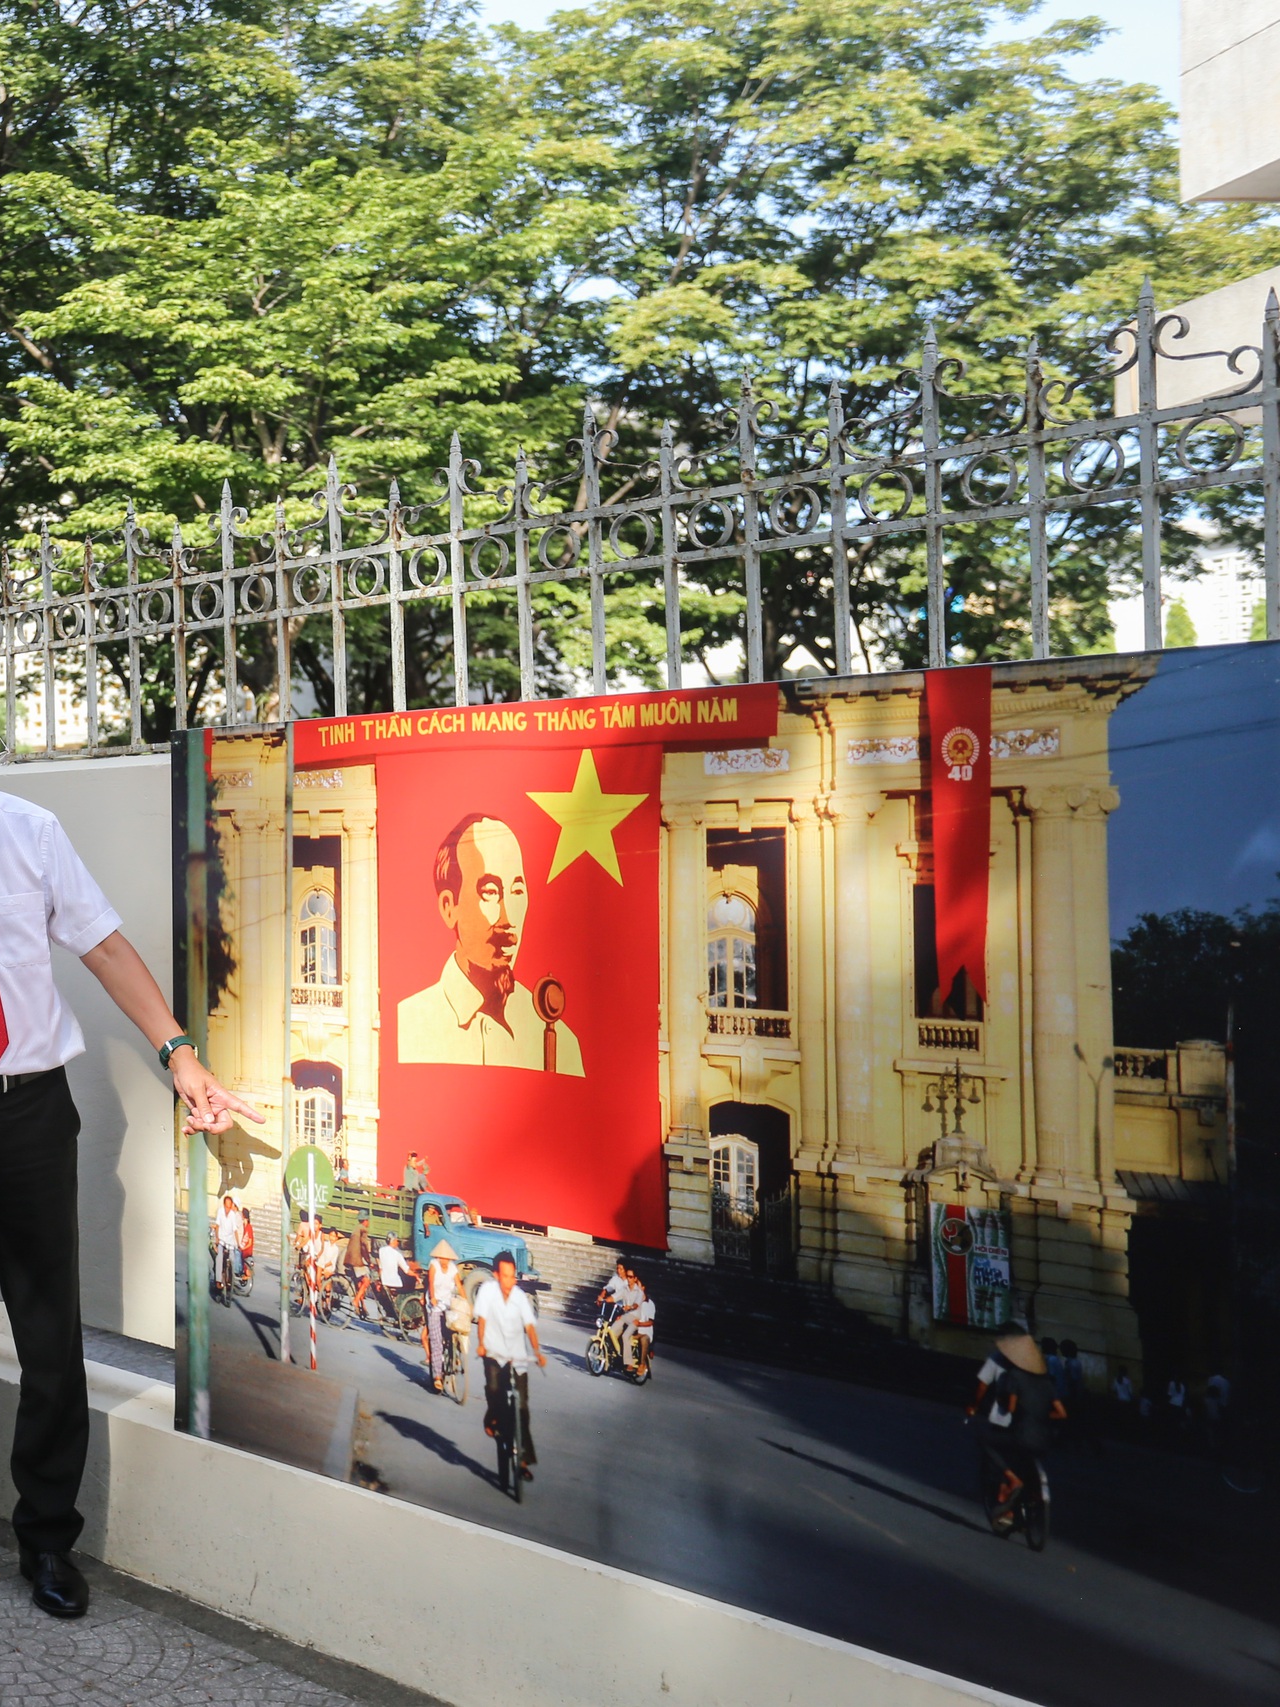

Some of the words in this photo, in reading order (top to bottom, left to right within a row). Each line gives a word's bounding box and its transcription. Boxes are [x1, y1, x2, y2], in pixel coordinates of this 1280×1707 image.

[318, 722, 355, 747] TINH
[361, 715, 412, 740] THẦN
[417, 711, 465, 735] CÁCH
[471, 711, 527, 733] MẠNG
[533, 707, 597, 731] THÁNG
[599, 702, 635, 728] TÁM
[640, 697, 691, 727] MUÔN
[697, 697, 738, 723] NĂM
[948, 765, 973, 781] 40
[314, 1183, 329, 1203] XE
